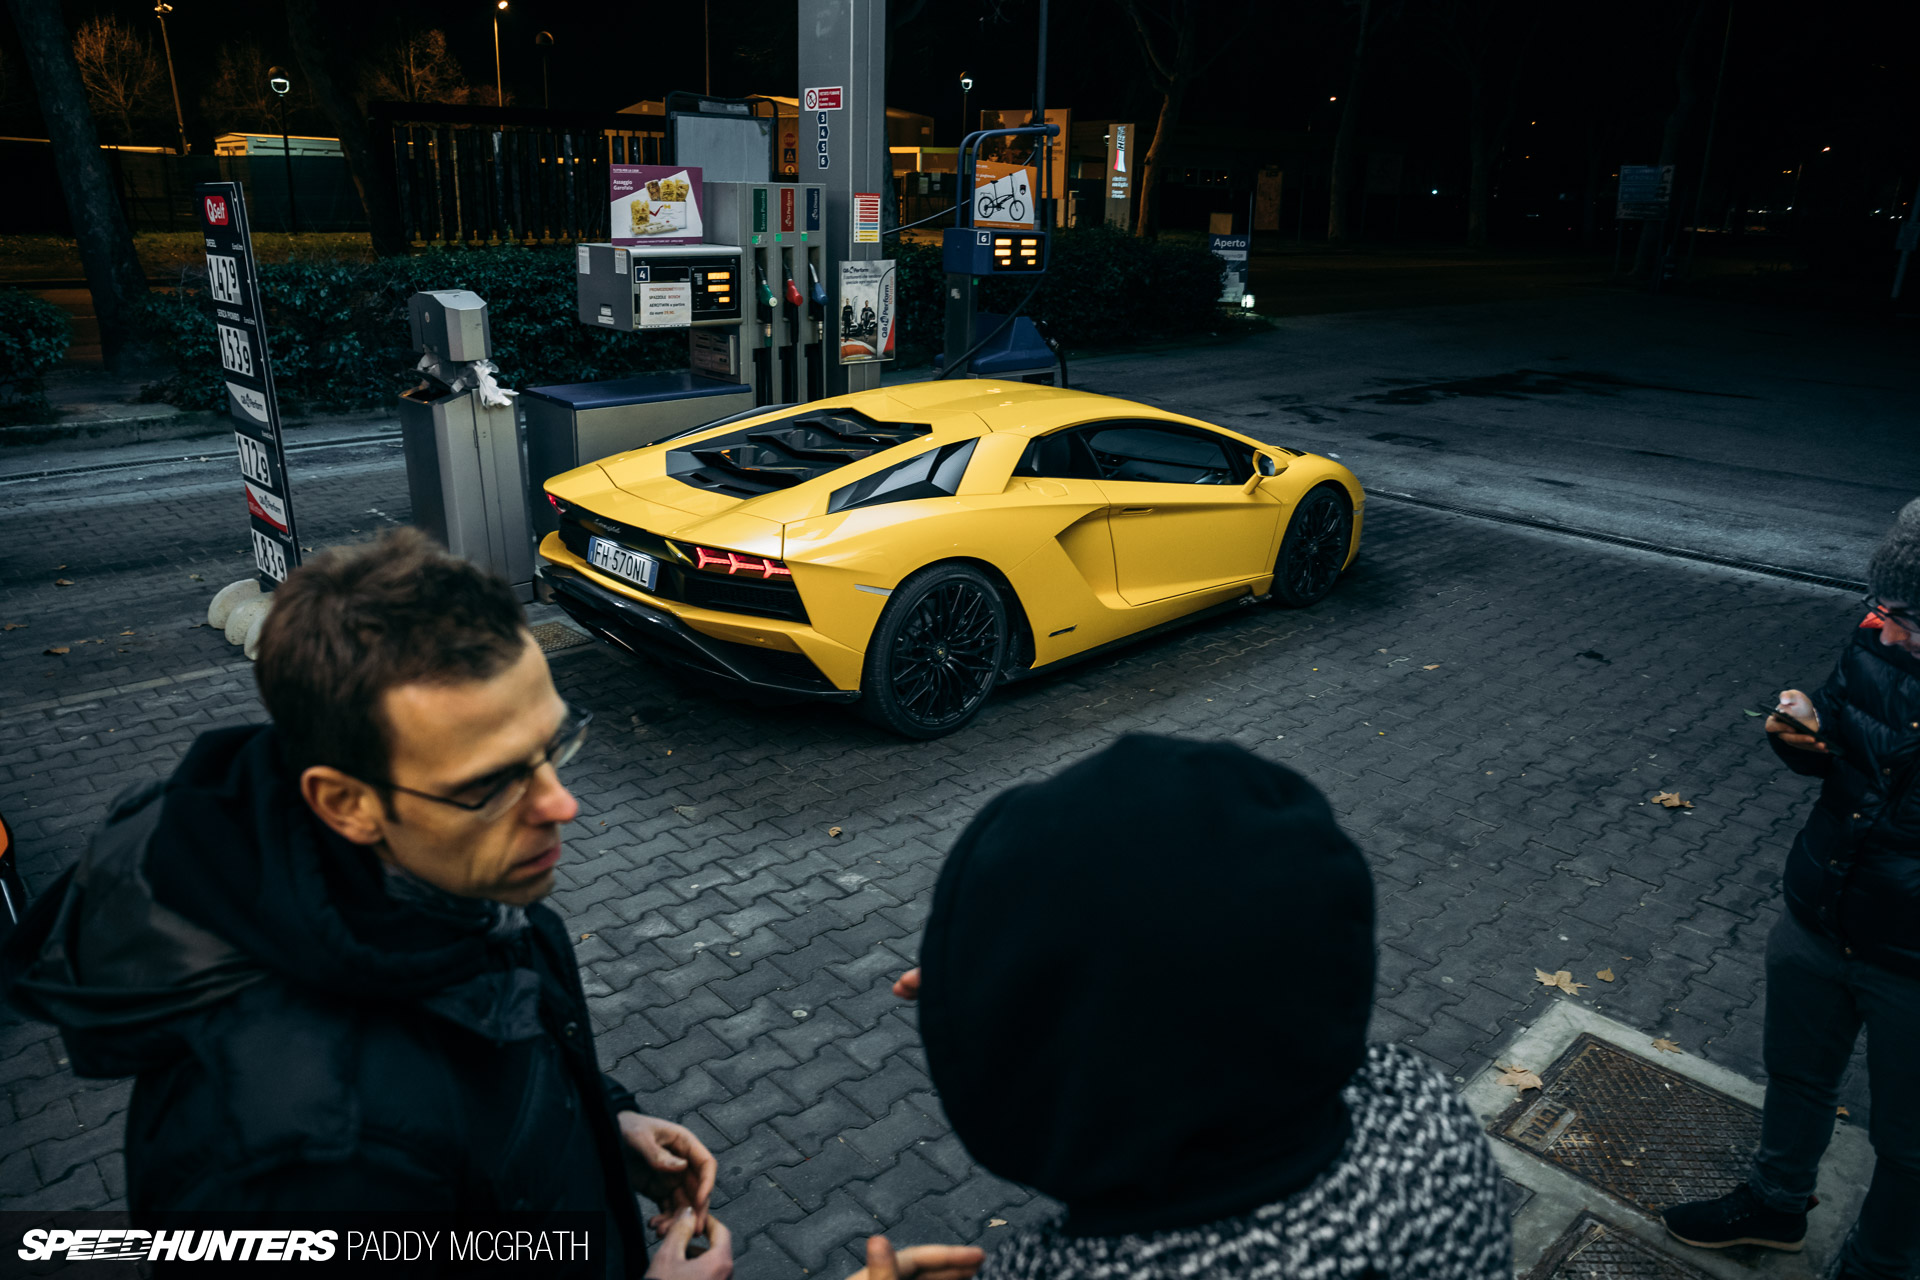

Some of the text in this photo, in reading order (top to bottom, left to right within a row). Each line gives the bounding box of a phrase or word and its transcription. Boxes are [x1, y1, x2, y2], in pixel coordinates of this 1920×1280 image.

[822, 144, 826, 152] 5
[820, 157, 826, 165] 6
[980, 234, 987, 242] 6
[1214, 238, 1246, 248] Aperto
[640, 270, 646, 280] 4
[882, 327, 888, 338] Q8
